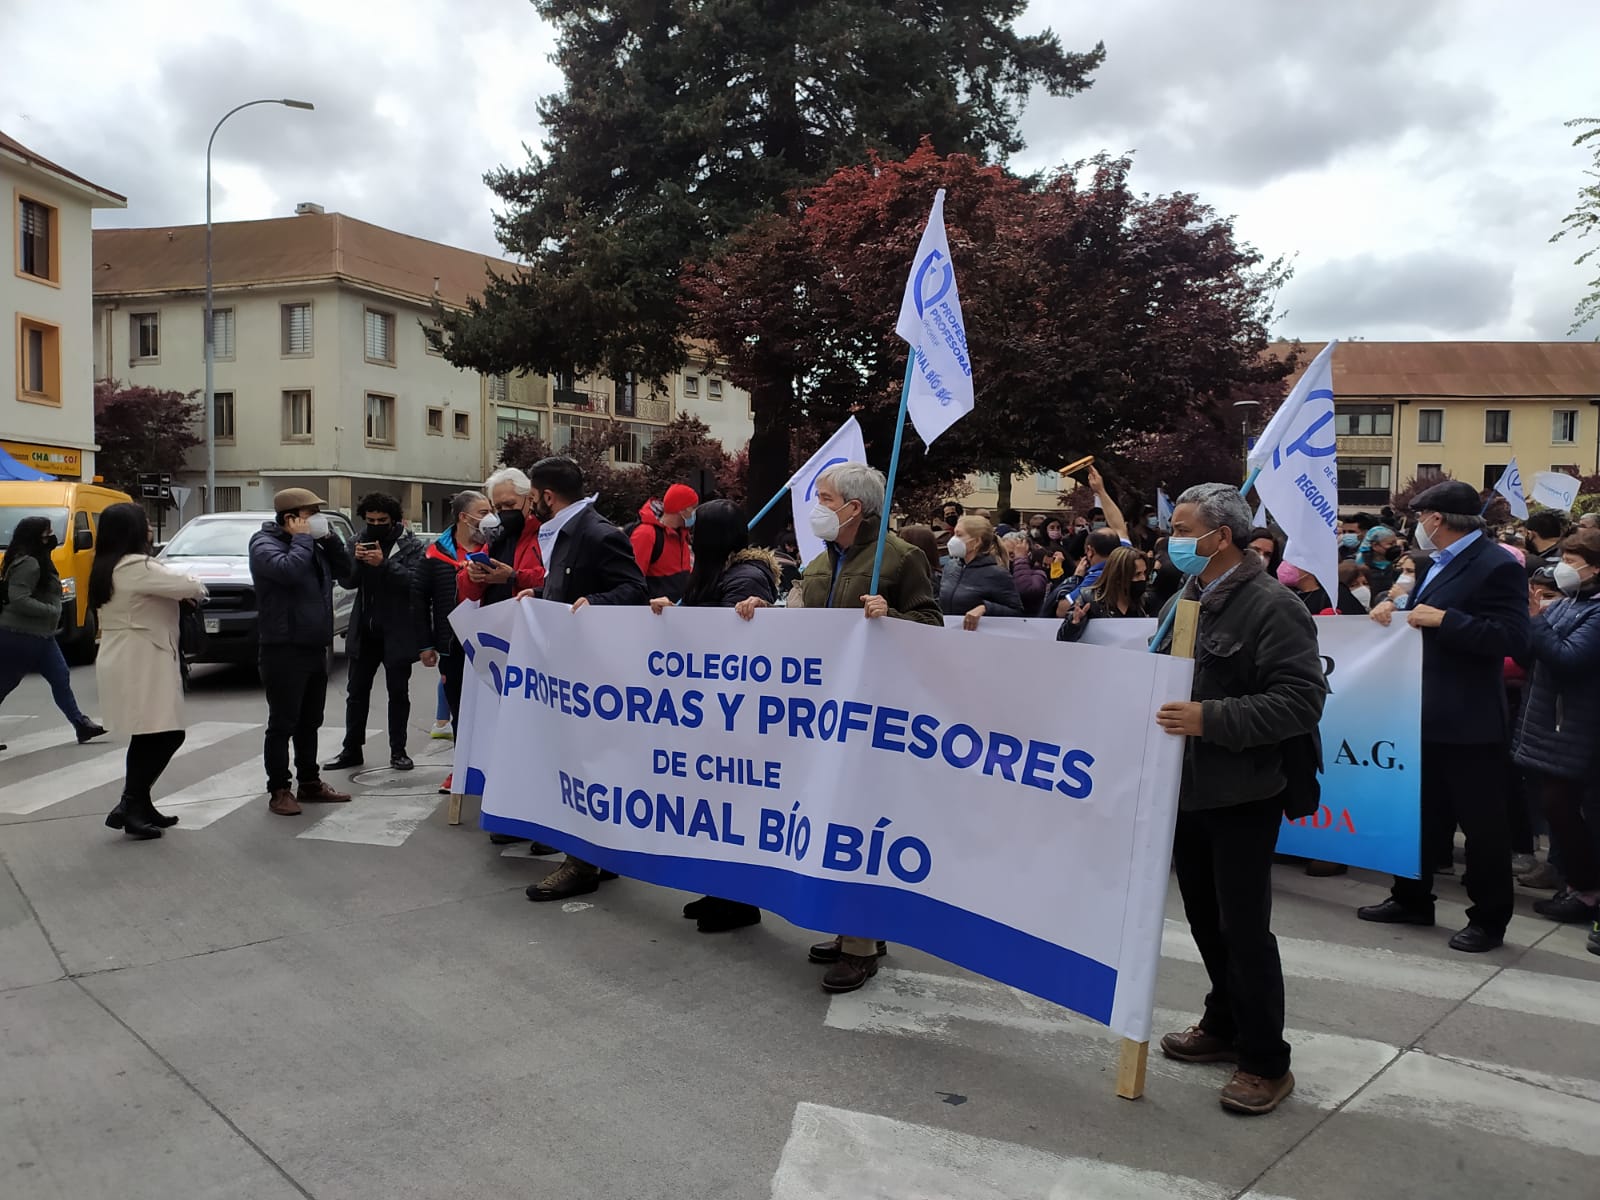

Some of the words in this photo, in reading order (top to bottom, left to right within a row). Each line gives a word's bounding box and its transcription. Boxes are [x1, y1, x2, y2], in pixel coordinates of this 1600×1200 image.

[930, 308, 972, 377] PROFESORAS
[1294, 473, 1337, 528] REGIONAL
[648, 651, 772, 682] COLEGIO
[781, 657, 822, 685] DE
[503, 665, 704, 729] PROFESORAS
[717, 692, 745, 732] Y
[758, 695, 1096, 800] PROFESORES
[1334, 738, 1405, 771] A.G.
[653, 749, 687, 778] DE
[696, 754, 782, 790] CHILE
[558, 769, 745, 847] REGIONAL
[758, 801, 811, 862] BÍO
[822, 816, 932, 884] BÍO
